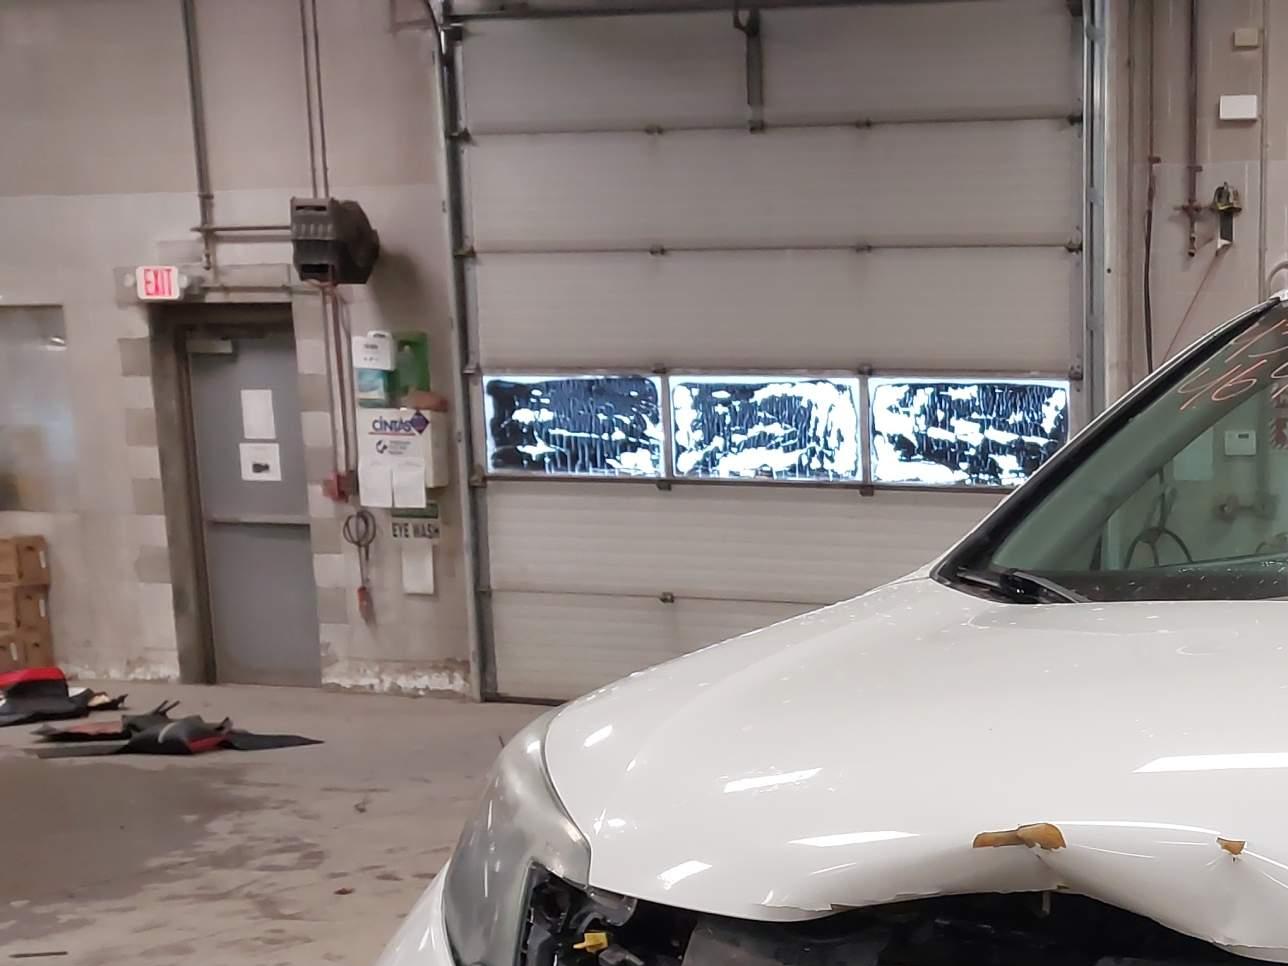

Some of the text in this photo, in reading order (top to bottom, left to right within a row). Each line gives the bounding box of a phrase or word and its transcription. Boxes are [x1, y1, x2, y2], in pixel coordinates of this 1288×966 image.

[143, 268, 172, 297] EXIT
[391, 522, 440, 539] EYE WASH
